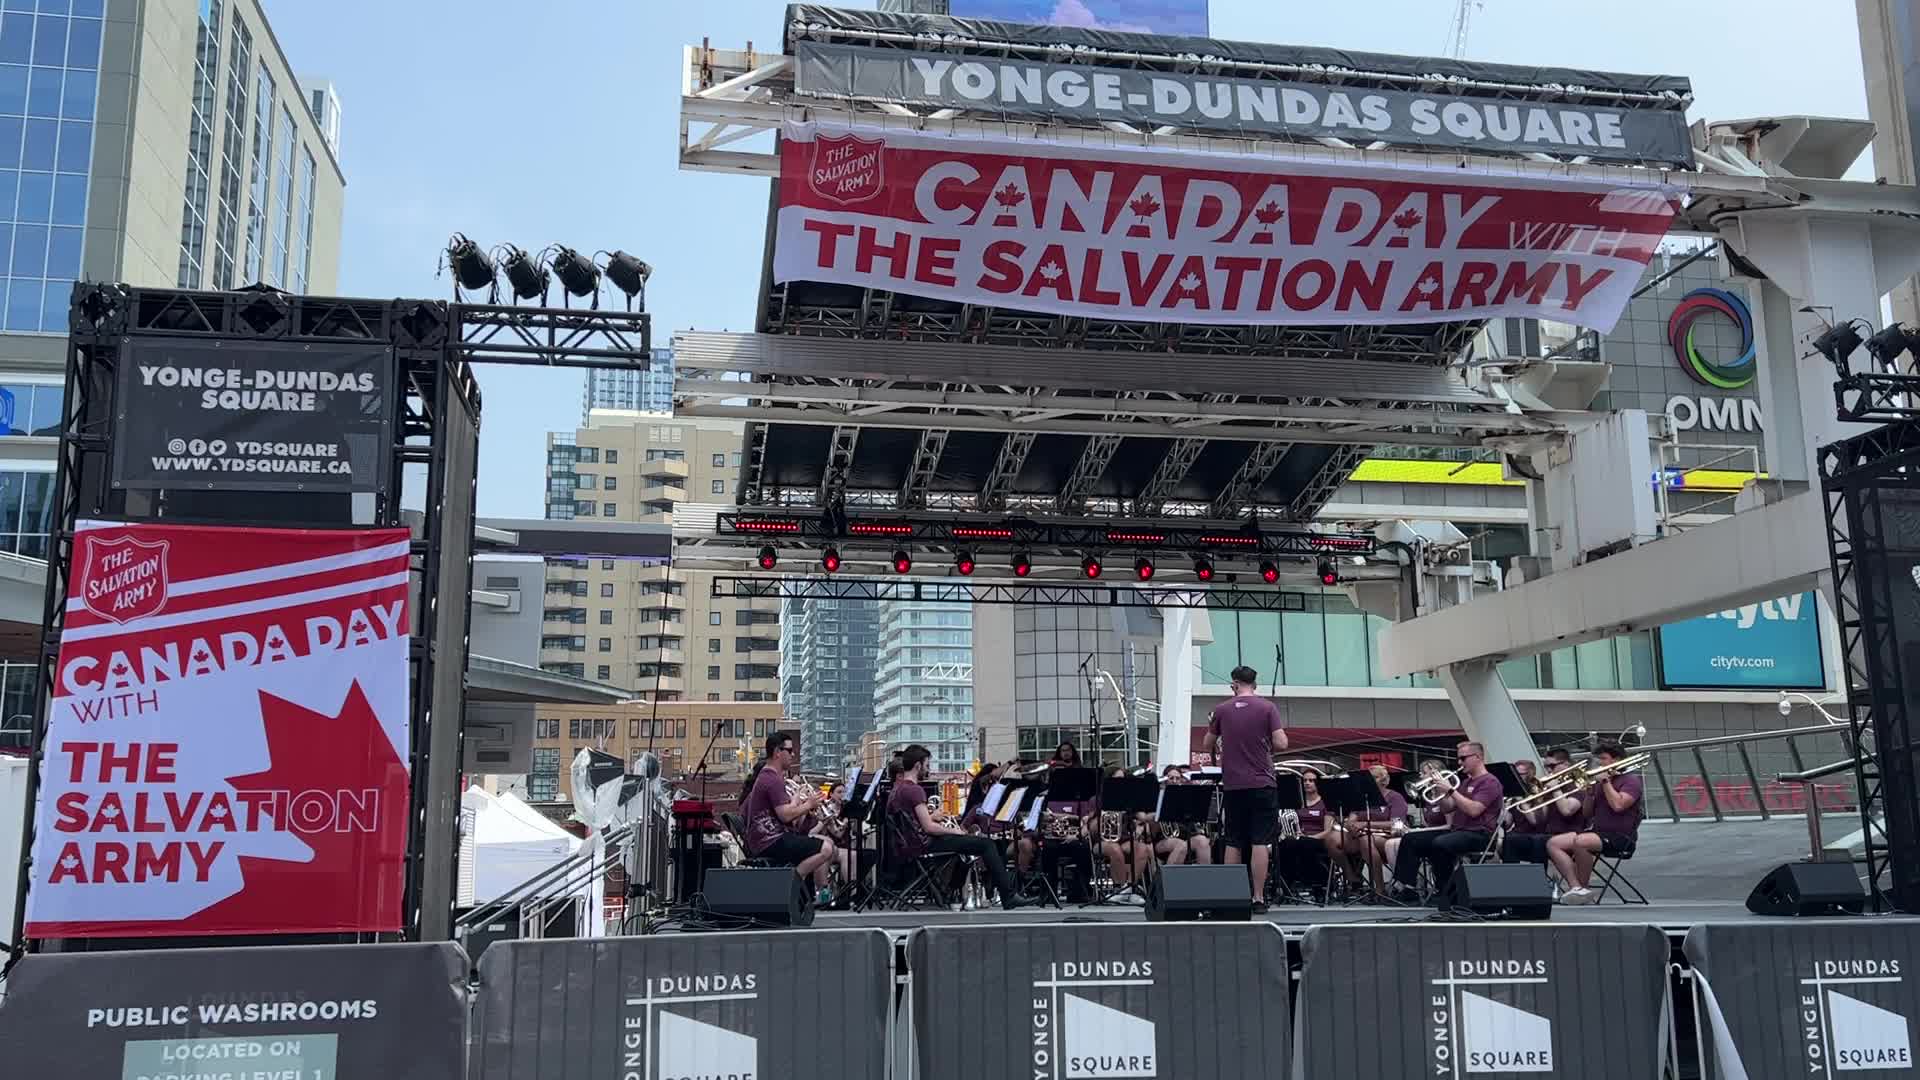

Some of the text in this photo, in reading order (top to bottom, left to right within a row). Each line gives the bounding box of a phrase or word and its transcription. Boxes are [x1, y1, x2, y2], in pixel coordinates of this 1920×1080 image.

[911, 58, 1627, 148] YONGE-DUNDAS SQUARE
[815, 150, 876, 185] SALVATION
[826, 143, 854, 164] THE
[835, 169, 874, 195] ARMY
[914, 160, 1628, 257] CANADA DAY WITH
[804, 219, 1616, 312] THE SALVATION ARMY
[139, 366, 374, 392] YONGE-DUNDAS
[201, 390, 316, 411] SQUARE
[1666, 395, 1763, 432] OMN
[236, 441, 338, 457] YDSQUARE
[152, 457, 352, 474] WWW.YDSQUARE.CA
[101, 547, 134, 572] THE
[88, 554, 159, 599] SALVATION
[112, 578, 157, 612] ARMY
[62, 599, 405, 696] CANADA DAY
[1710, 655, 1775, 669] citytv.com
[71, 690, 159, 724] WITH
[61, 743, 178, 783] THE
[54, 789, 378, 833] SALVATION
[48, 842, 226, 884] ARMY
[1064, 961, 1153, 977] DUNDAS
[1460, 960, 1546, 975] DUNDAS
[1824, 960, 1900, 976] DUNDAS
[660, 974, 757, 993] DUNDAS
[87, 1000, 377, 1028] PUBLIC WASHROOMS
[1033, 998, 1049, 1080] YONGE
[1432, 995, 1450, 1075] YONGE
[1802, 995, 1823, 1073] YONGE
[162, 1041, 301, 1061] LOCATED ON
[624, 1017, 641, 1080] ONGE
[1471, 1051, 1549, 1070] SQUARE
[1840, 1048, 1908, 1067] SQUARE
[1071, 1055, 1152, 1075] SQUARE
